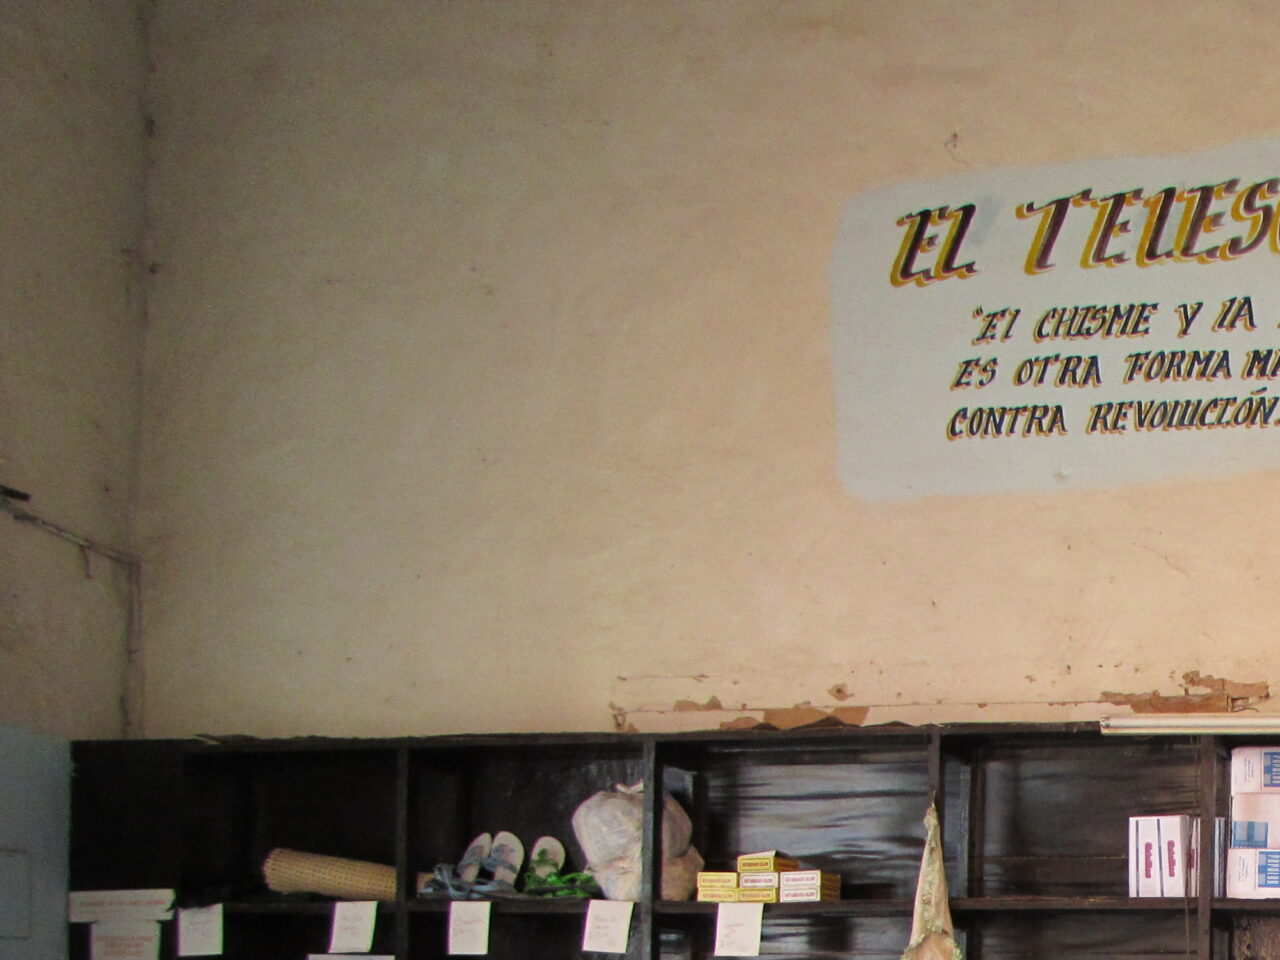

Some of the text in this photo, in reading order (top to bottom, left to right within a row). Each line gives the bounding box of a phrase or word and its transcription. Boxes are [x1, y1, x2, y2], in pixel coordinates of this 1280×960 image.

[891, 204, 978, 288] EL
[1033, 302, 1159, 342] CHISME
[1175, 302, 1203, 338] Y
[1211, 296, 1257, 332] LA
[950, 357, 999, 391] ES
[1013, 352, 1102, 388] OTRA
[1123, 348, 1232, 384] FORMA
[946, 404, 1067, 442] CONTRA
